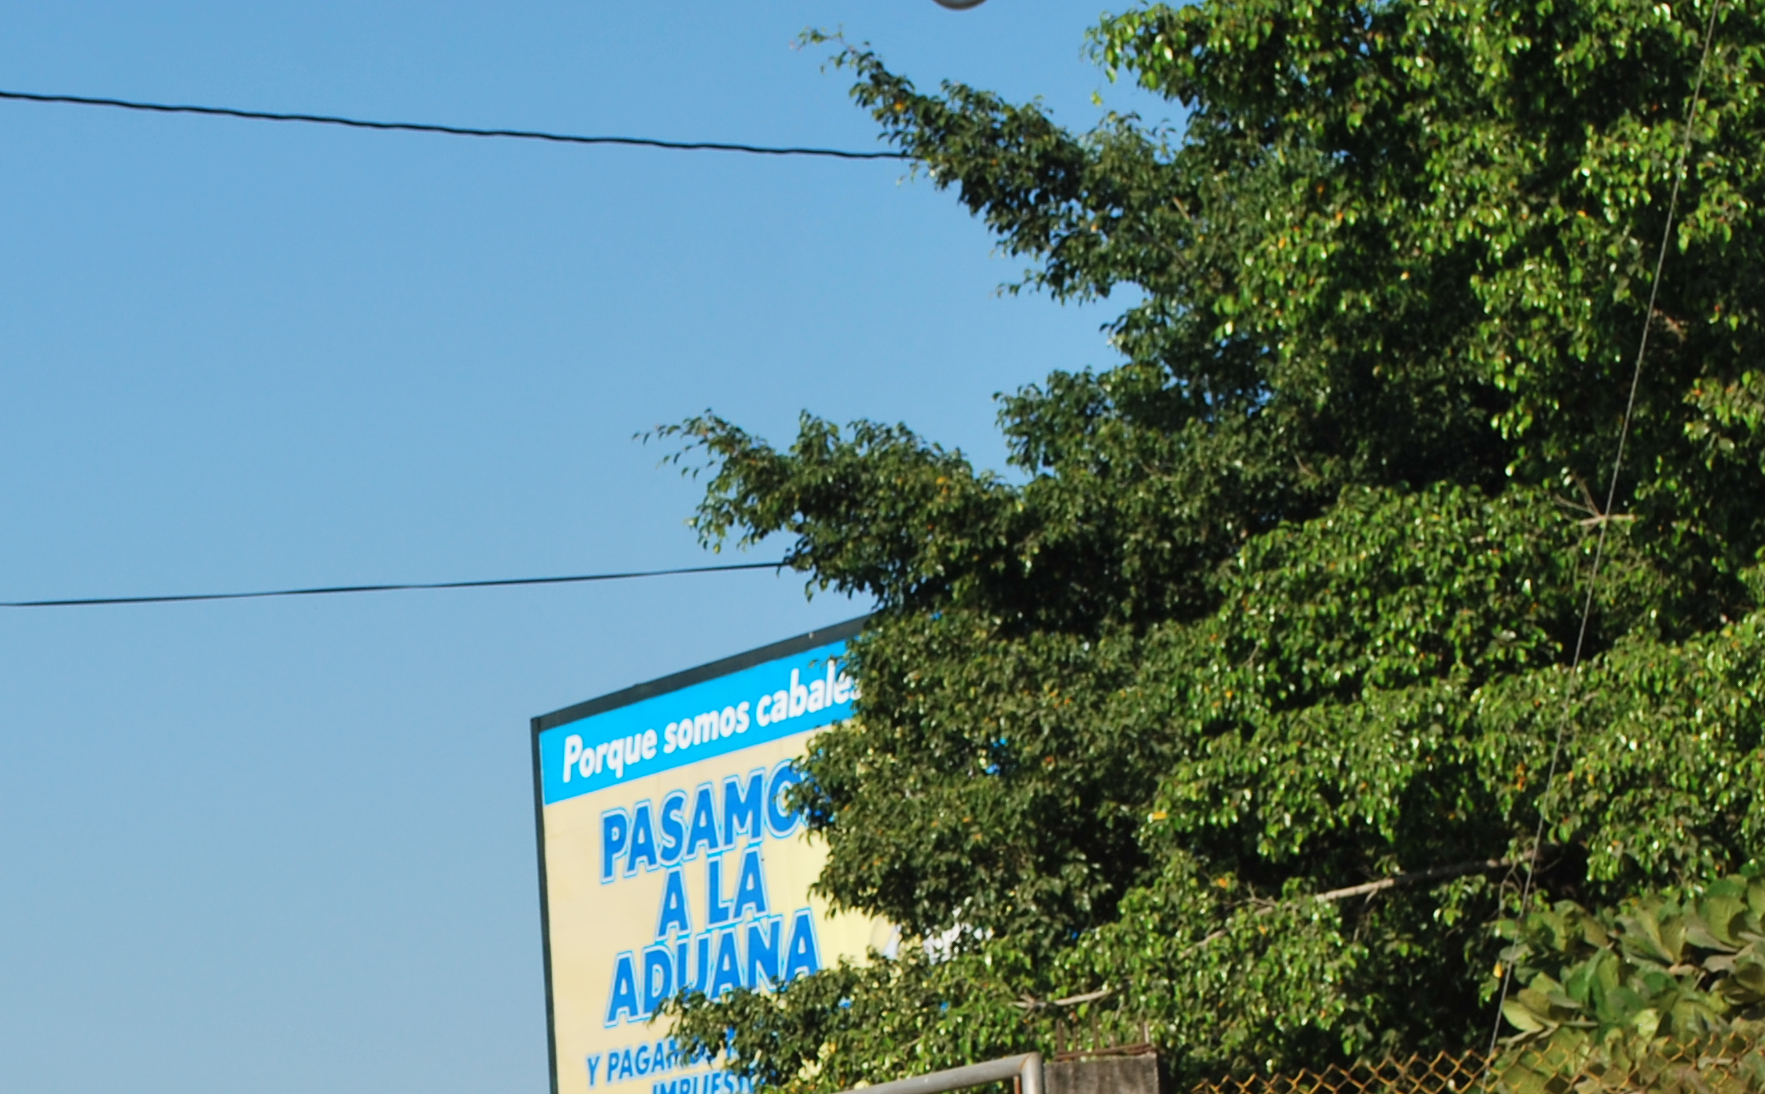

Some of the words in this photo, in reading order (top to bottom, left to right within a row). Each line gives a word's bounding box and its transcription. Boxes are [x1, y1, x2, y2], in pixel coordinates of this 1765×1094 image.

[562, 728, 657, 783] Porque
[663, 700, 750, 754] somos
[600, 758, 834, 884] PASAMO
[655, 863, 691, 943] A
[704, 845, 770, 930] LA
[604, 907, 822, 1028] ADUANA
[586, 1054, 602, 1088] Y
